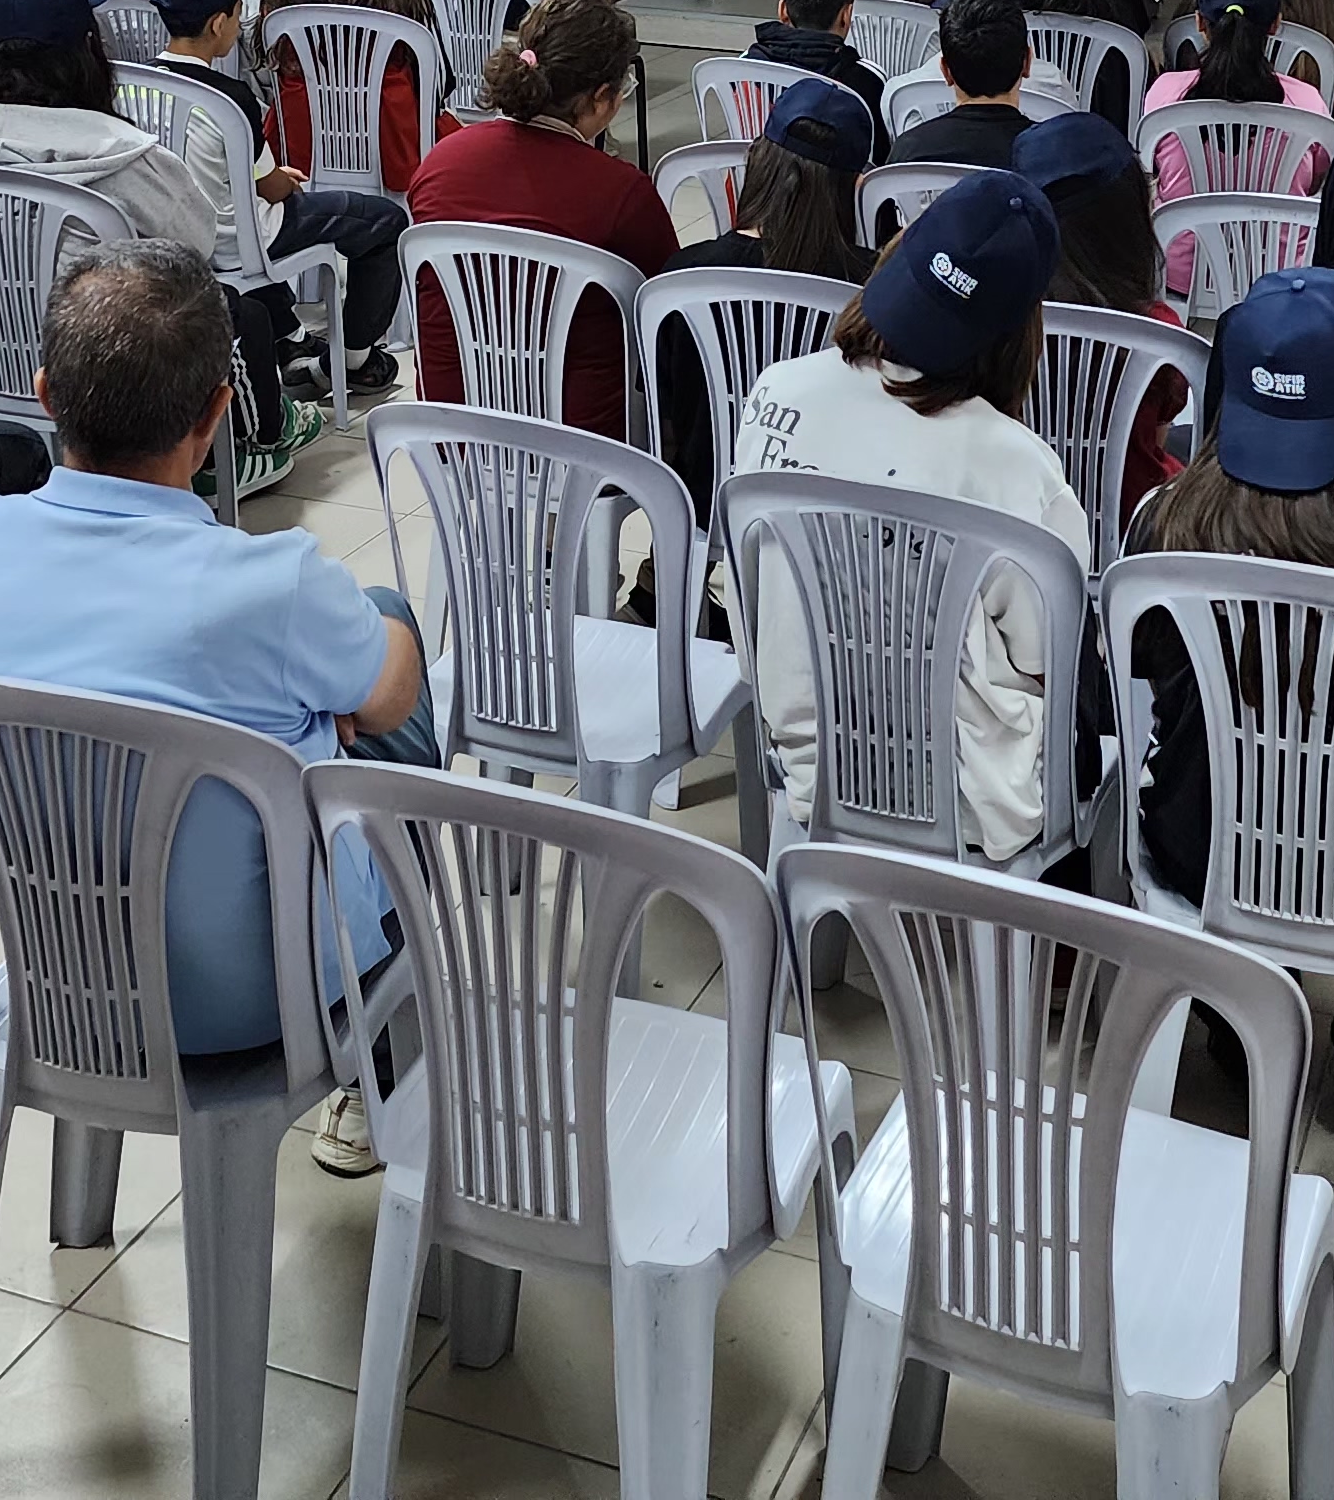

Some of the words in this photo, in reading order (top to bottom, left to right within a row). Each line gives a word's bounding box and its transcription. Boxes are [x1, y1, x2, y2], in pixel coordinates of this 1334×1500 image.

[947, 274, 971, 295] ATIK
[951, 266, 979, 291] SIFIR
[1273, 373, 1306, 384] SIFIR
[1274, 382, 1306, 395] ATIK
[743, 385, 802, 437] San
